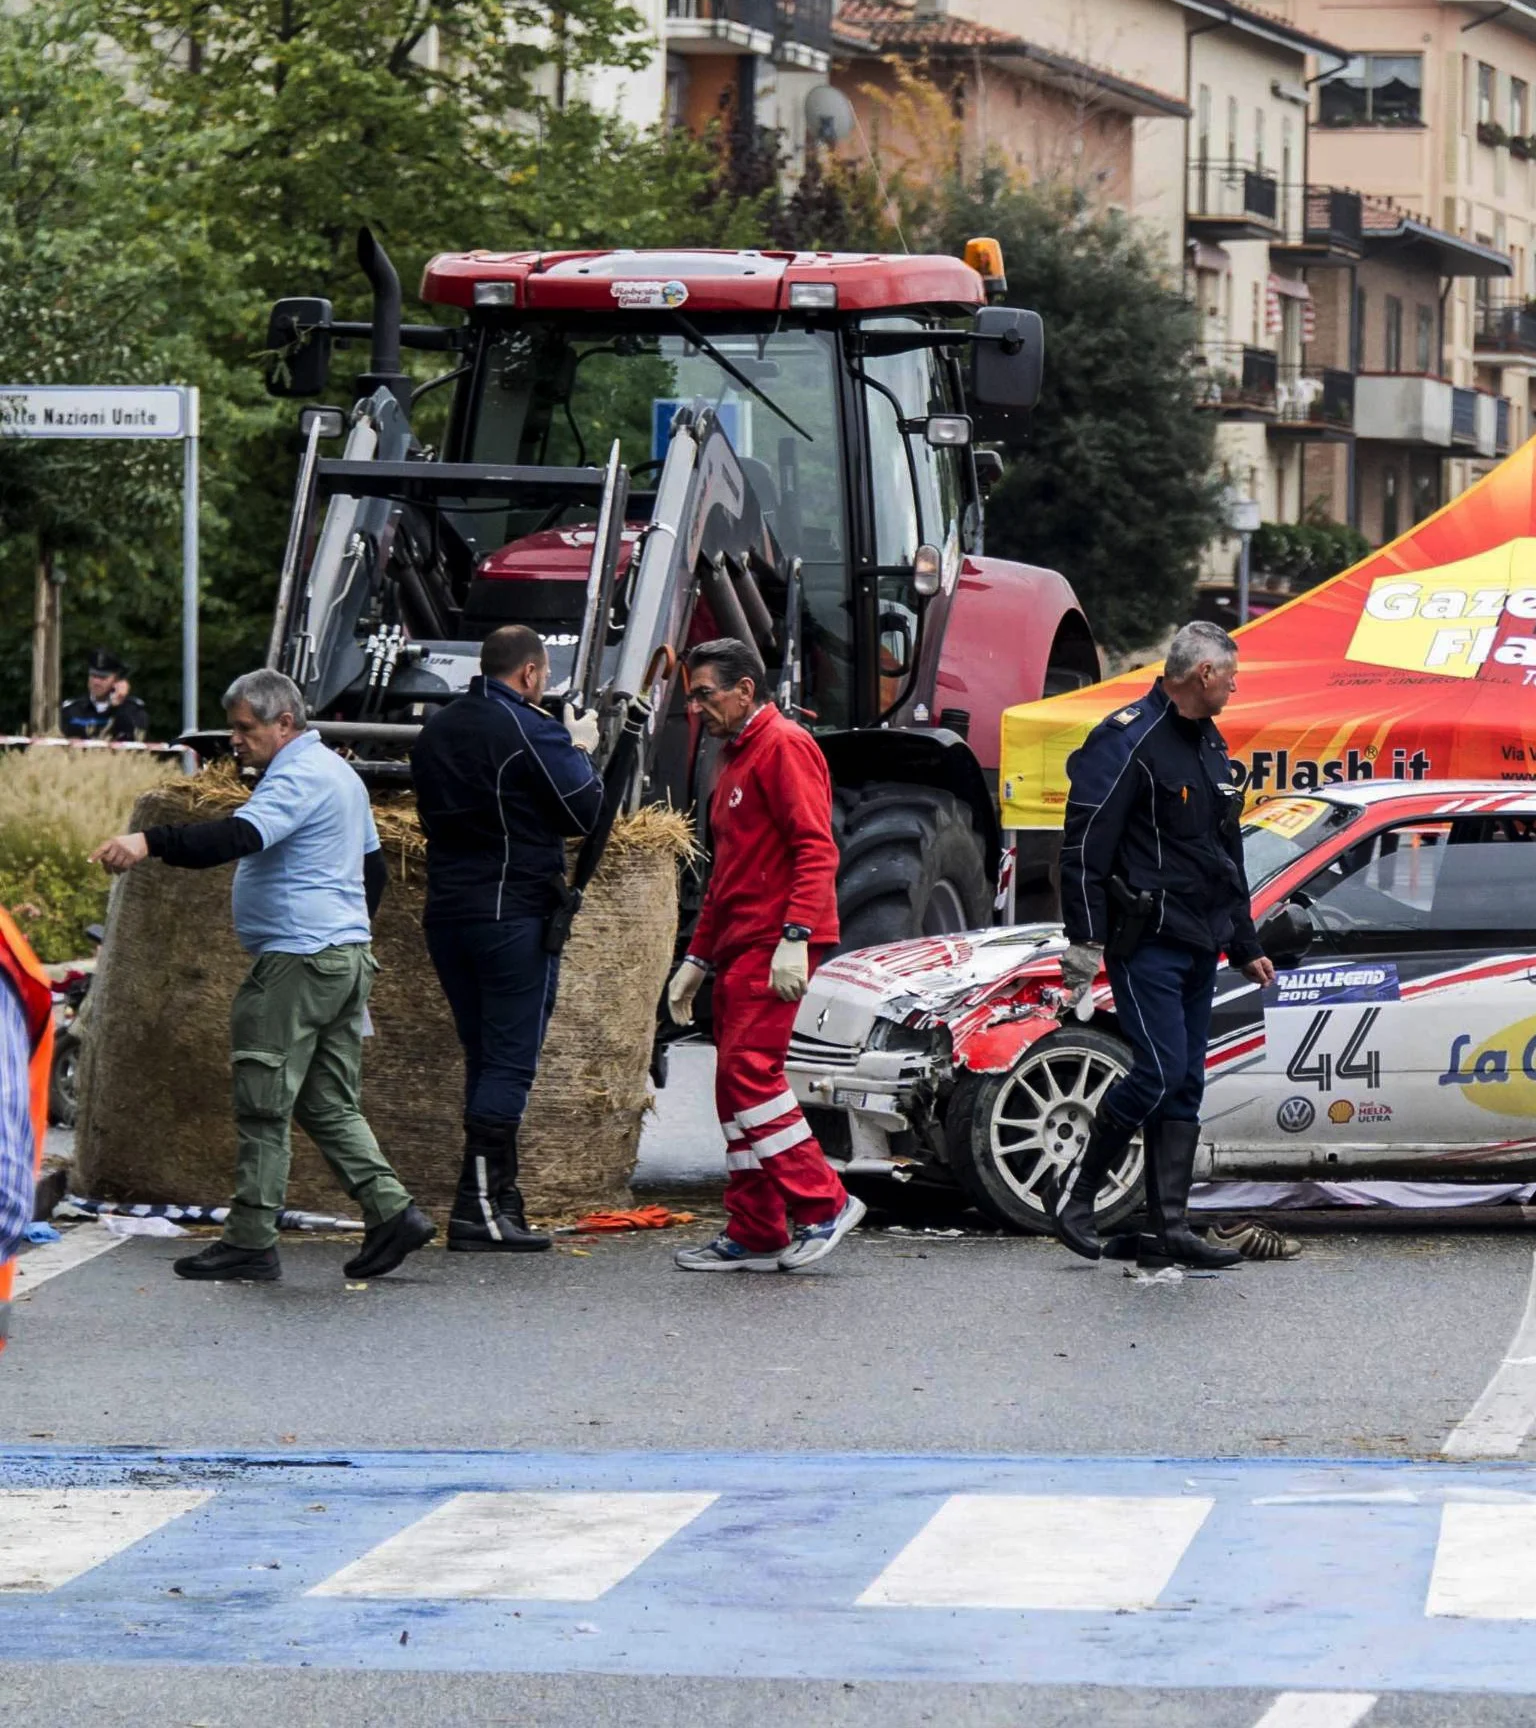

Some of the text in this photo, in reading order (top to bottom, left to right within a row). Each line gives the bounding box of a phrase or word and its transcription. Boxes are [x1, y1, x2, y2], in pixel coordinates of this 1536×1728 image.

[44, 408, 105, 426] Nazioni
[112, 408, 157, 426] Unite
[1502, 746, 1525, 761] Via
[1277, 970, 1386, 991] RALLYLEGEND
[1277, 990, 1321, 1002] 2016
[1286, 1006, 1382, 1092] 44
[1438, 1034, 1509, 1086] La
[1359, 1106, 1393, 1115] HELIX
[1358, 1115, 1392, 1123] ULTRA
